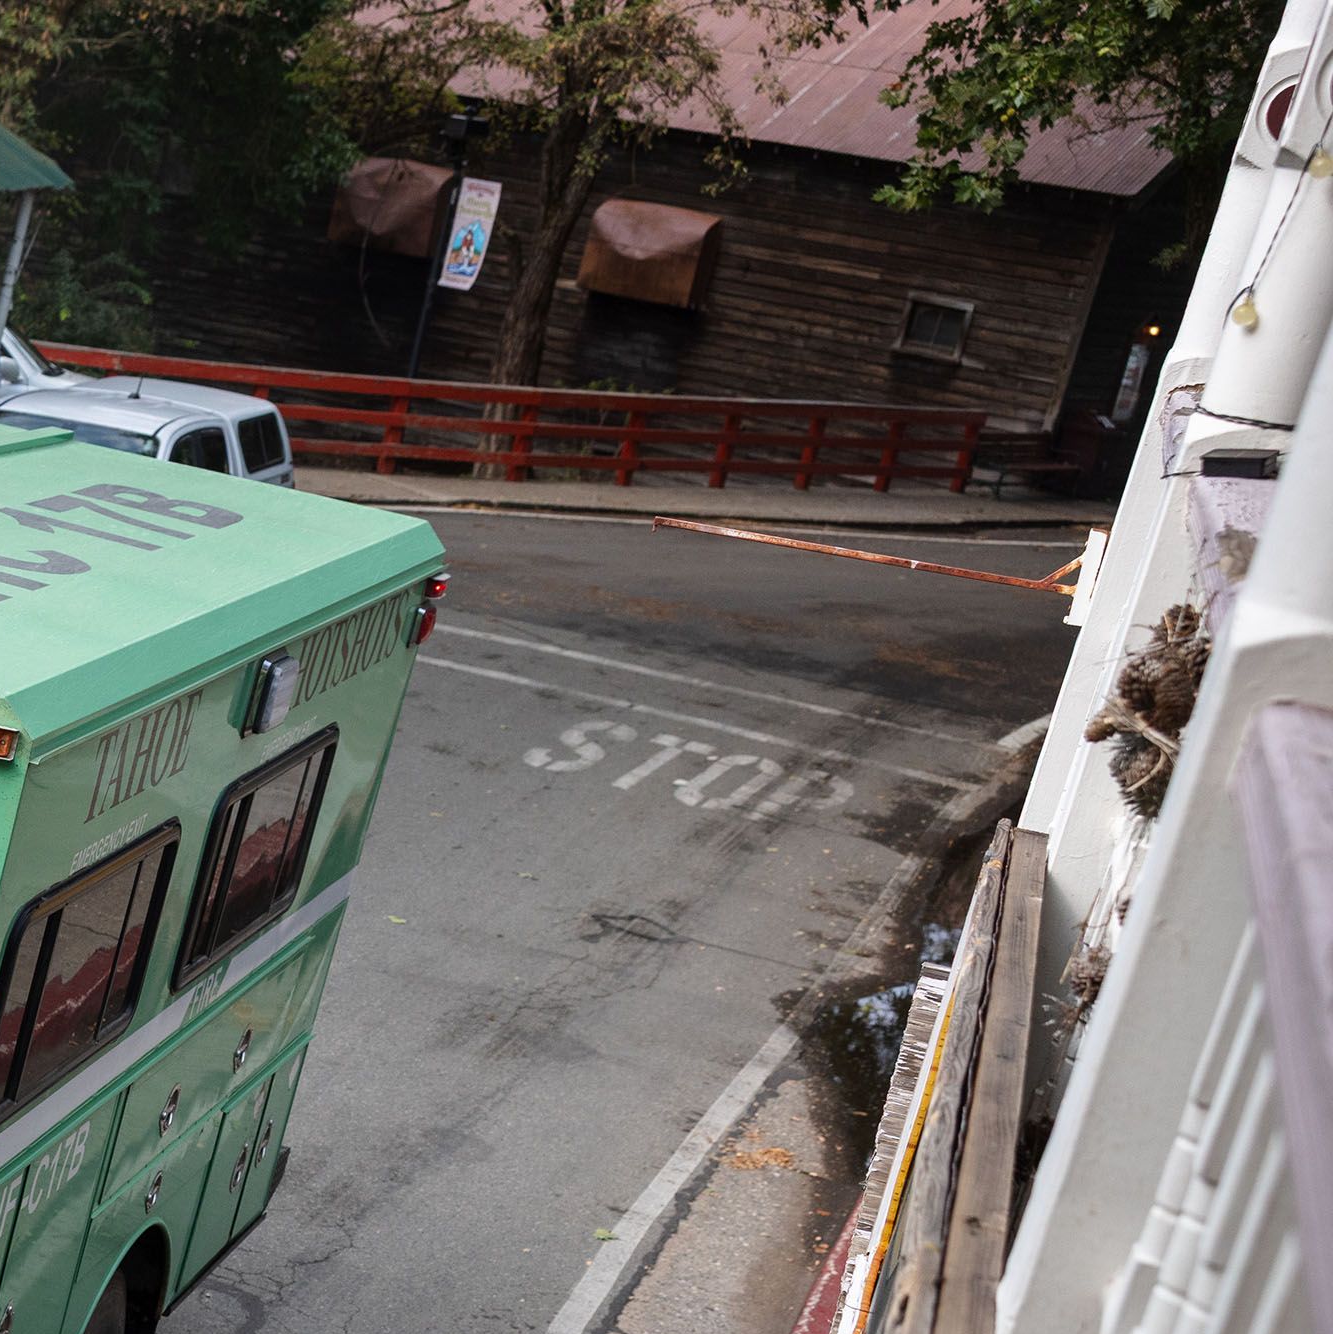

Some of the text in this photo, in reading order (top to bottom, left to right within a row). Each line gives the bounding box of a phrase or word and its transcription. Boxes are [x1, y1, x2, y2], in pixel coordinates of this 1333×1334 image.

[84, 588, 410, 826] TAHOE HOTSHOTS
[522, 720, 855, 822] STOP
[70, 812, 149, 877] EMERGENCY EXIT
[189, 965, 223, 1019] FIRE
